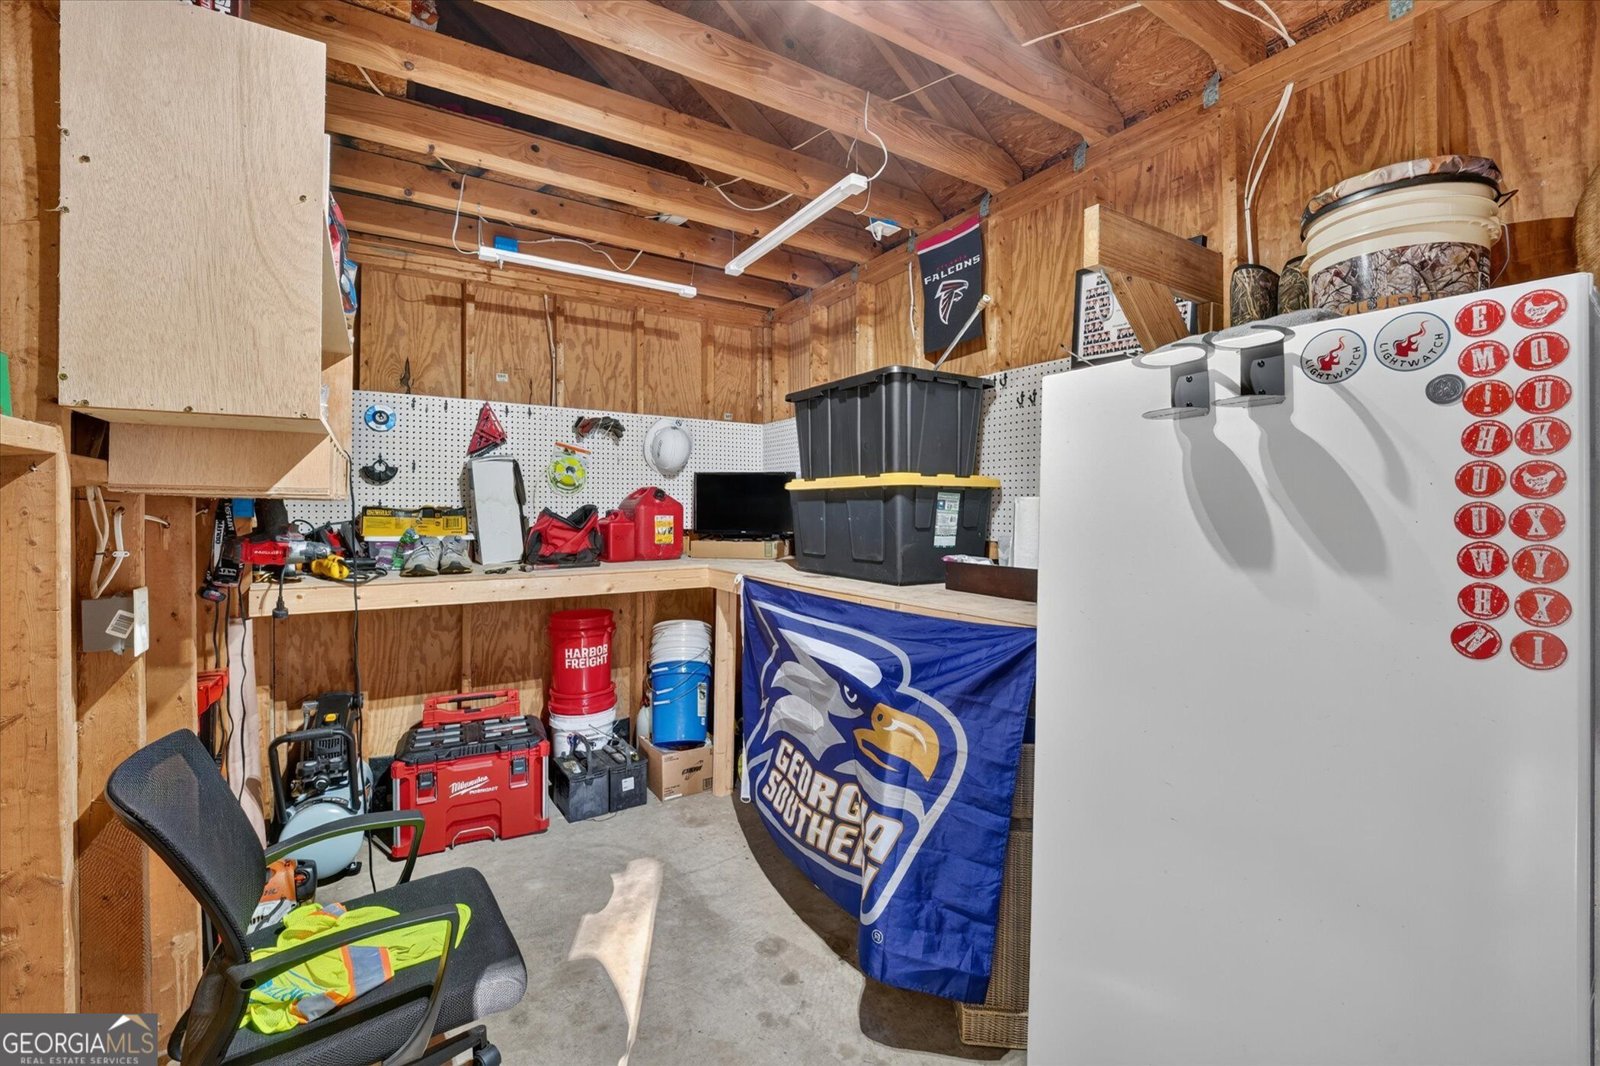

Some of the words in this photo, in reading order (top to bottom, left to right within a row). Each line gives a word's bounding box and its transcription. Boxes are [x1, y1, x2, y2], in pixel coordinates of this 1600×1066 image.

[924, 254, 981, 286] FALCONS
[1472, 305, 1488, 332] E
[1305, 346, 1361, 381] LIGHTWATCH
[1380, 332, 1444, 368] LIGHTWATCH
[1471, 346, 1496, 372] M
[1530, 338, 1553, 366] Q
[1534, 380, 1553, 409] U
[1475, 425, 1500, 452] H
[1532, 421, 1554, 450] K
[1472, 466, 1489, 492] U
[1470, 507, 1488, 533] U
[1525, 507, 1548, 536] X
[1531, 550, 1551, 578] Y
[1473, 587, 1492, 615] H
[1531, 593, 1555, 622] X
[564, 644, 608, 659] HARBOR
[565, 653, 608, 669] FREIGHT
[1532, 636, 1545, 664] I
[762, 768, 880, 901] SOUTHE
